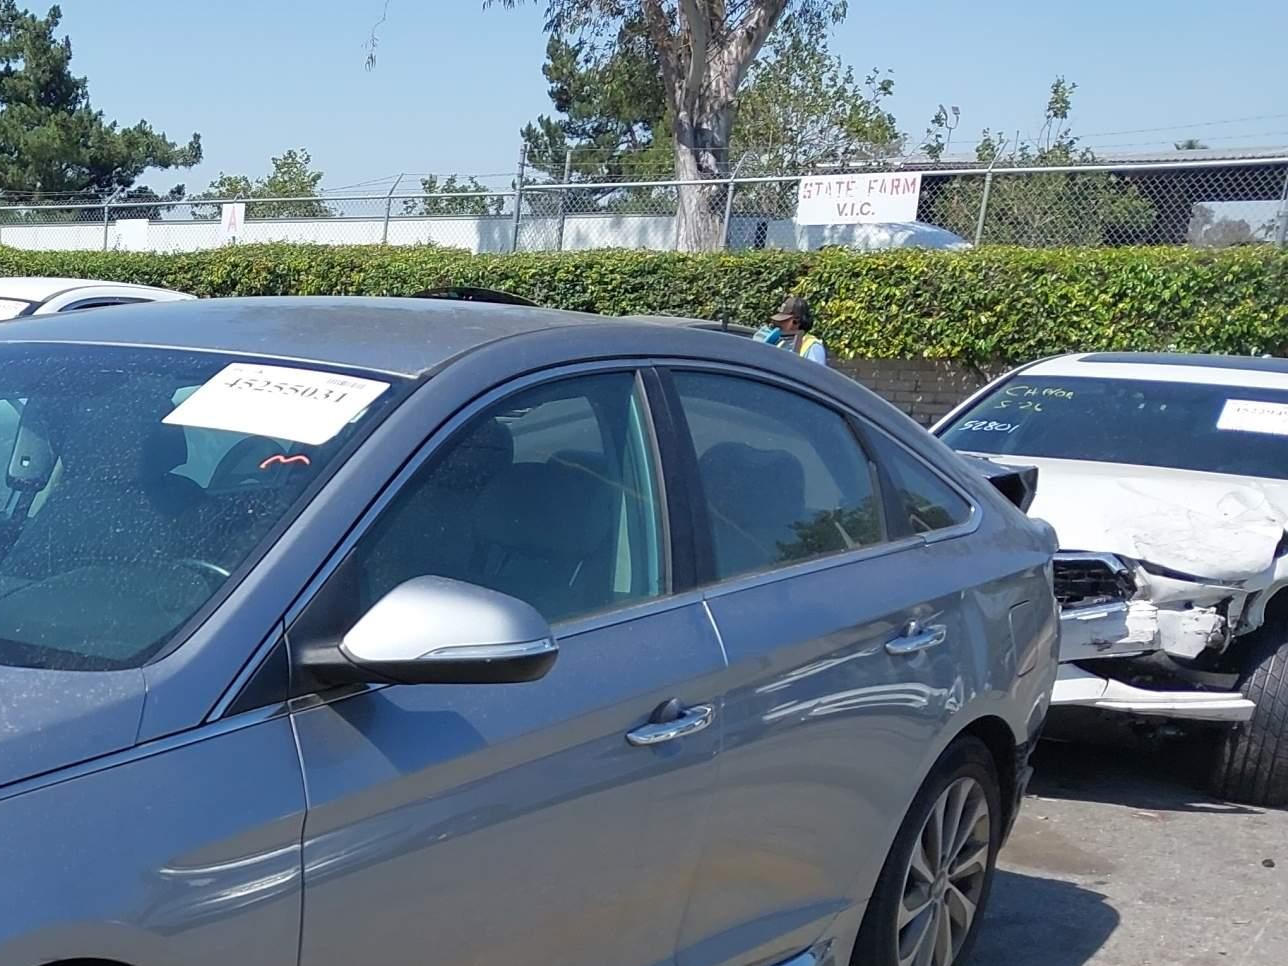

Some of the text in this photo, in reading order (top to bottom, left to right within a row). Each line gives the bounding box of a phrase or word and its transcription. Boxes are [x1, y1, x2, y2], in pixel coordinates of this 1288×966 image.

[802, 177, 918, 200] STATE FARM
[226, 205, 238, 233] A
[836, 201, 875, 217] V.I.C.
[223, 376, 349, 403] 45255031
